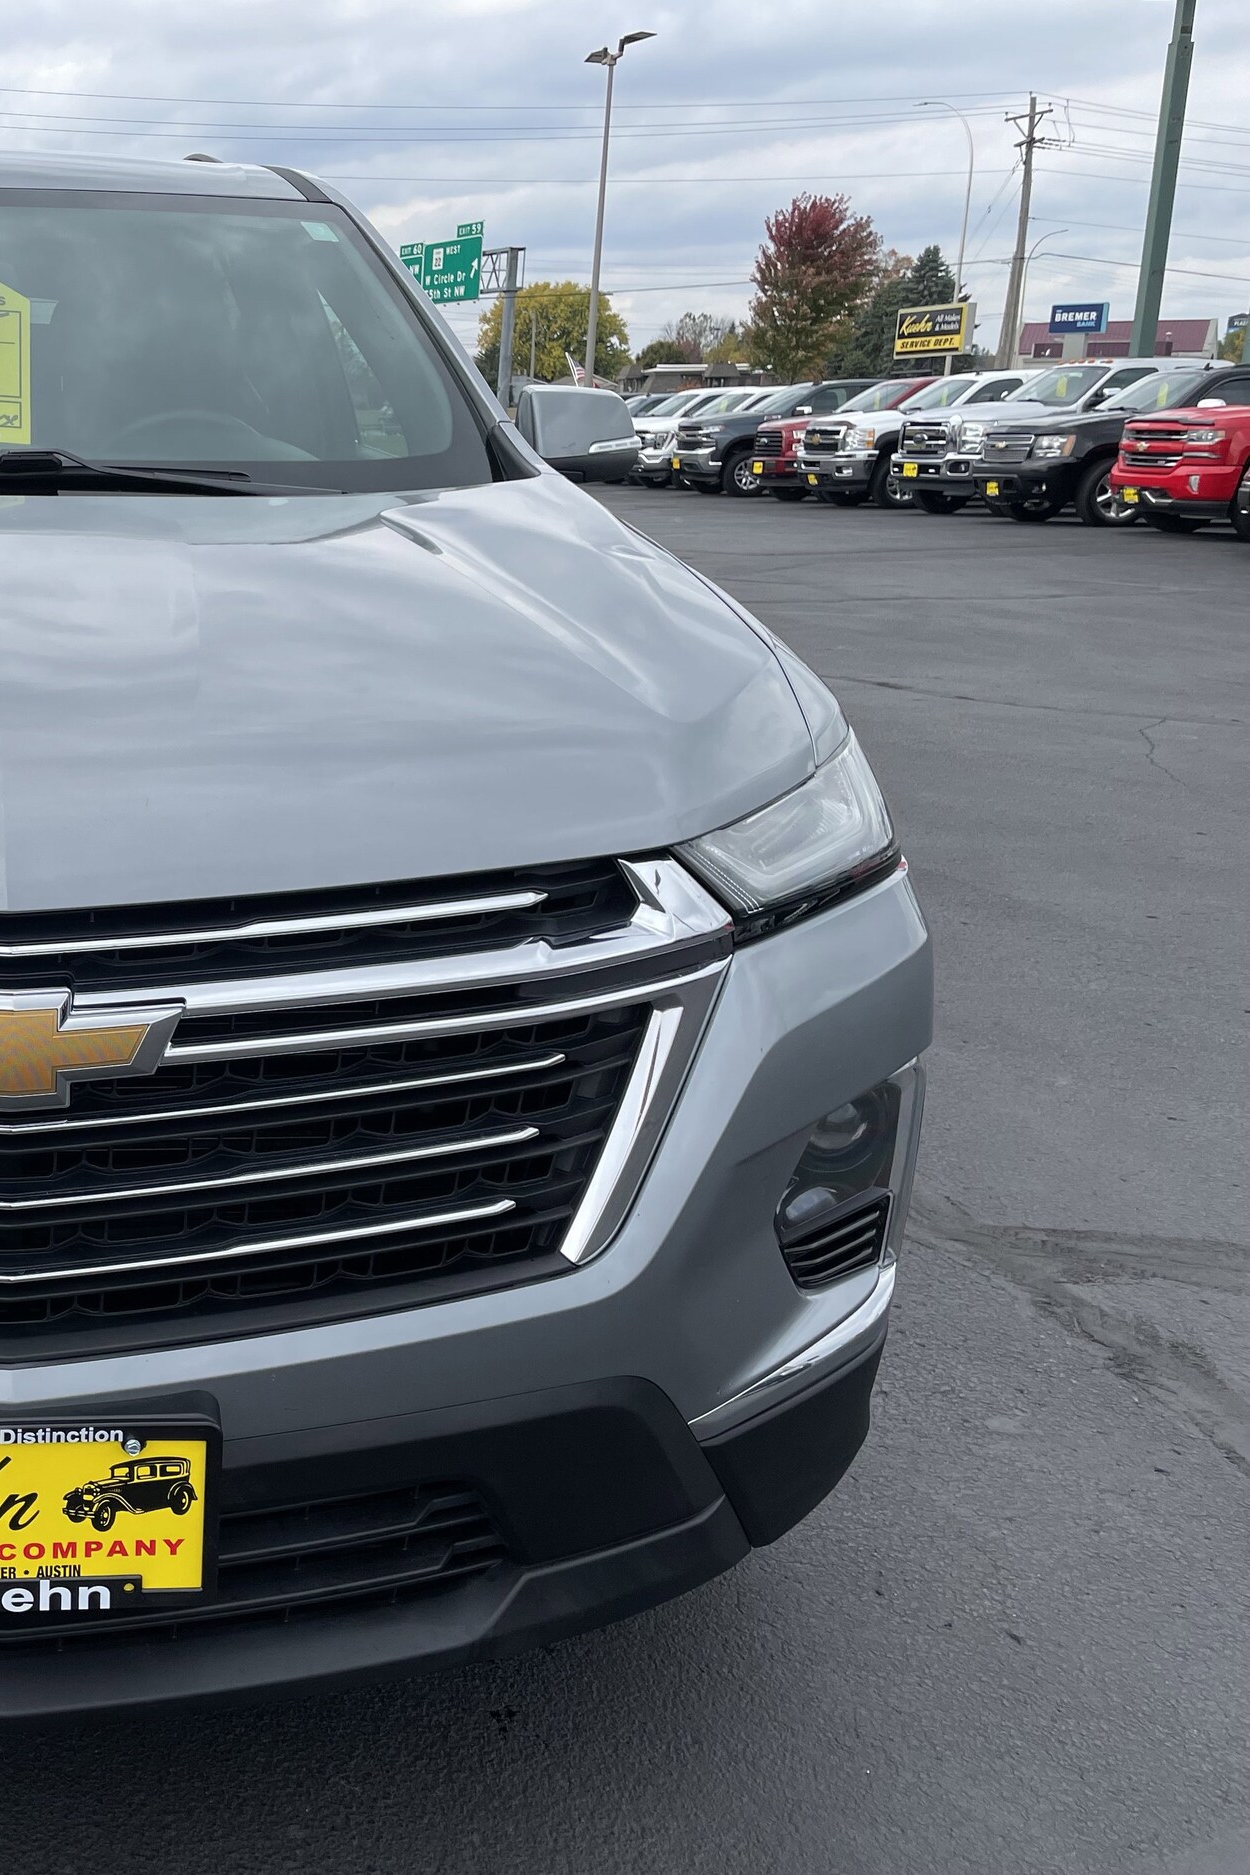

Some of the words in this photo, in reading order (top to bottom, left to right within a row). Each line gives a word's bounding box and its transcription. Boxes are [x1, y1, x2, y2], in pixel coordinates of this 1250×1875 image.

[459, 226, 470, 235] EXIT
[471, 223, 481, 234] 59
[401, 247, 411, 255] EXIT
[413, 244, 421, 254] 60
[446, 245, 461, 255] WEST
[434, 257, 441, 267] 22
[425, 275, 431, 285] W
[433, 273, 454, 285] Circle
[457, 271, 466, 282] Dr
[443, 287, 452, 298] St
[454, 285, 465, 297] NW
[1054, 311, 1097, 322] BREMER
[899, 313, 933, 336] Kuehn
[1076, 320, 1096, 328] BANK
[900, 339, 931, 349] SERVICE
[933, 337, 955, 347] DEPT.
[0, 1427, 124, 1445] Distinction
[36, 1565, 81, 1579] AUSTIN
